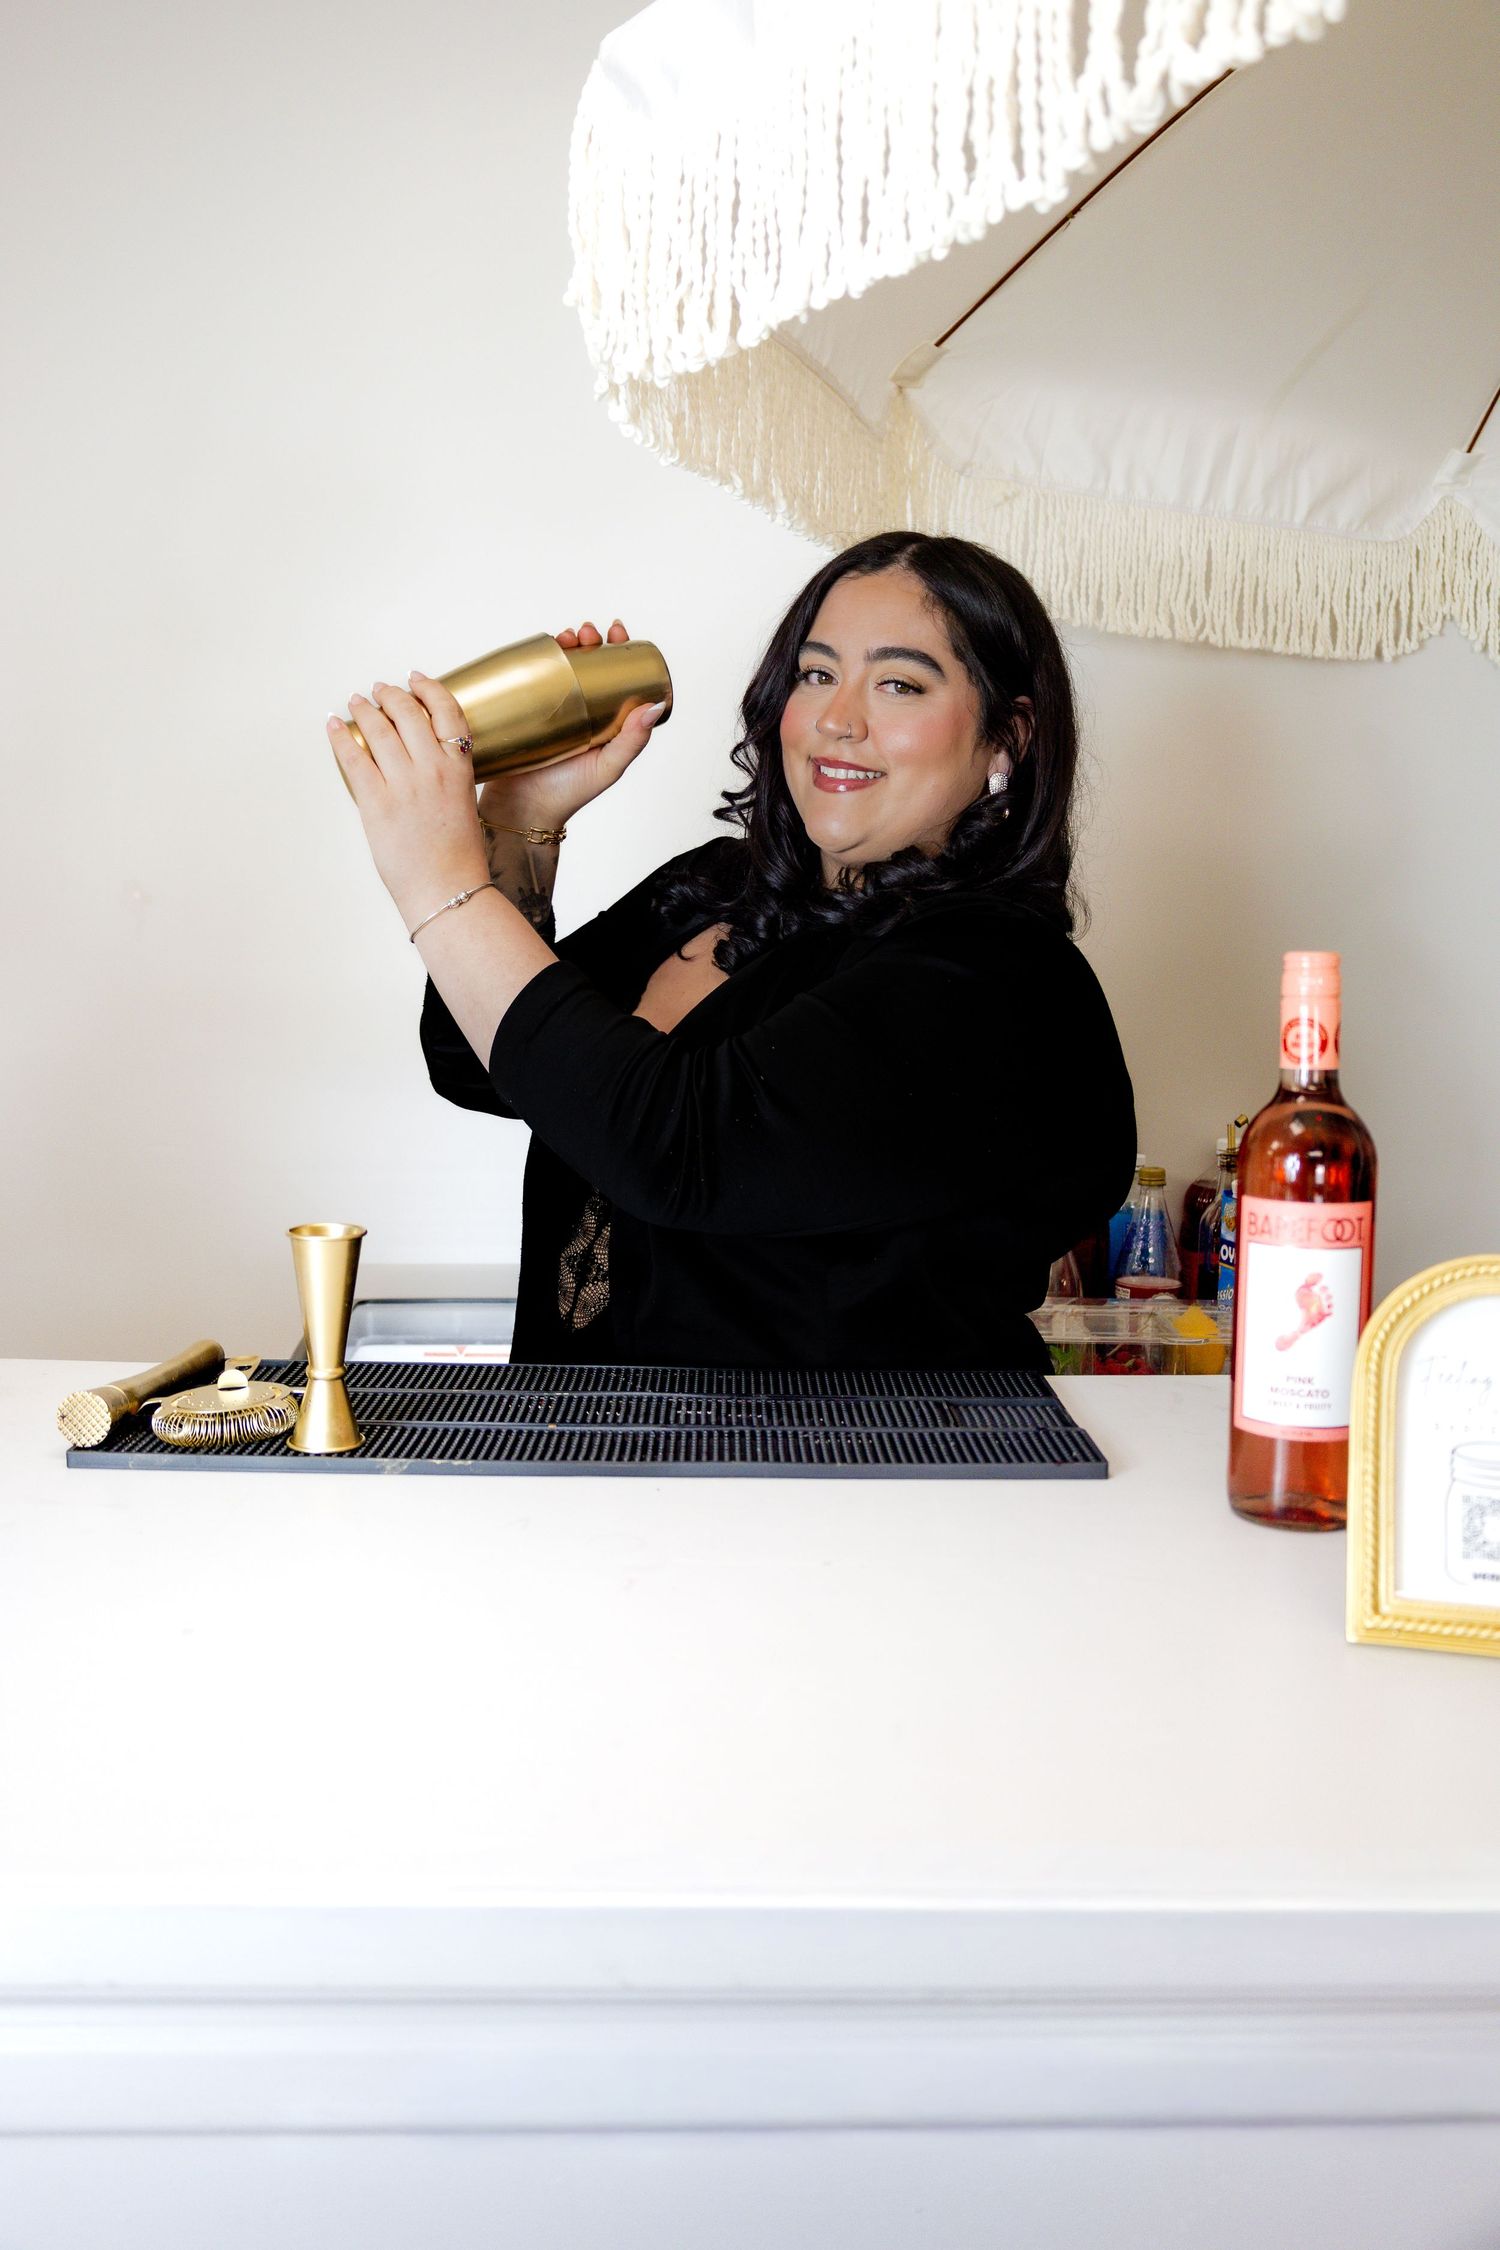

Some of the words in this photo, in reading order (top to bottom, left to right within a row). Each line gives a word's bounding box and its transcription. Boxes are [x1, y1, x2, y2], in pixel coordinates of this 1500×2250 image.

[1247, 1210, 1364, 1243] BAREFOOT
[1219, 1243, 1236, 1264] OY
[1286, 1375, 1315, 1386] PINK
[1270, 1386, 1330, 1399] MOSCATO
